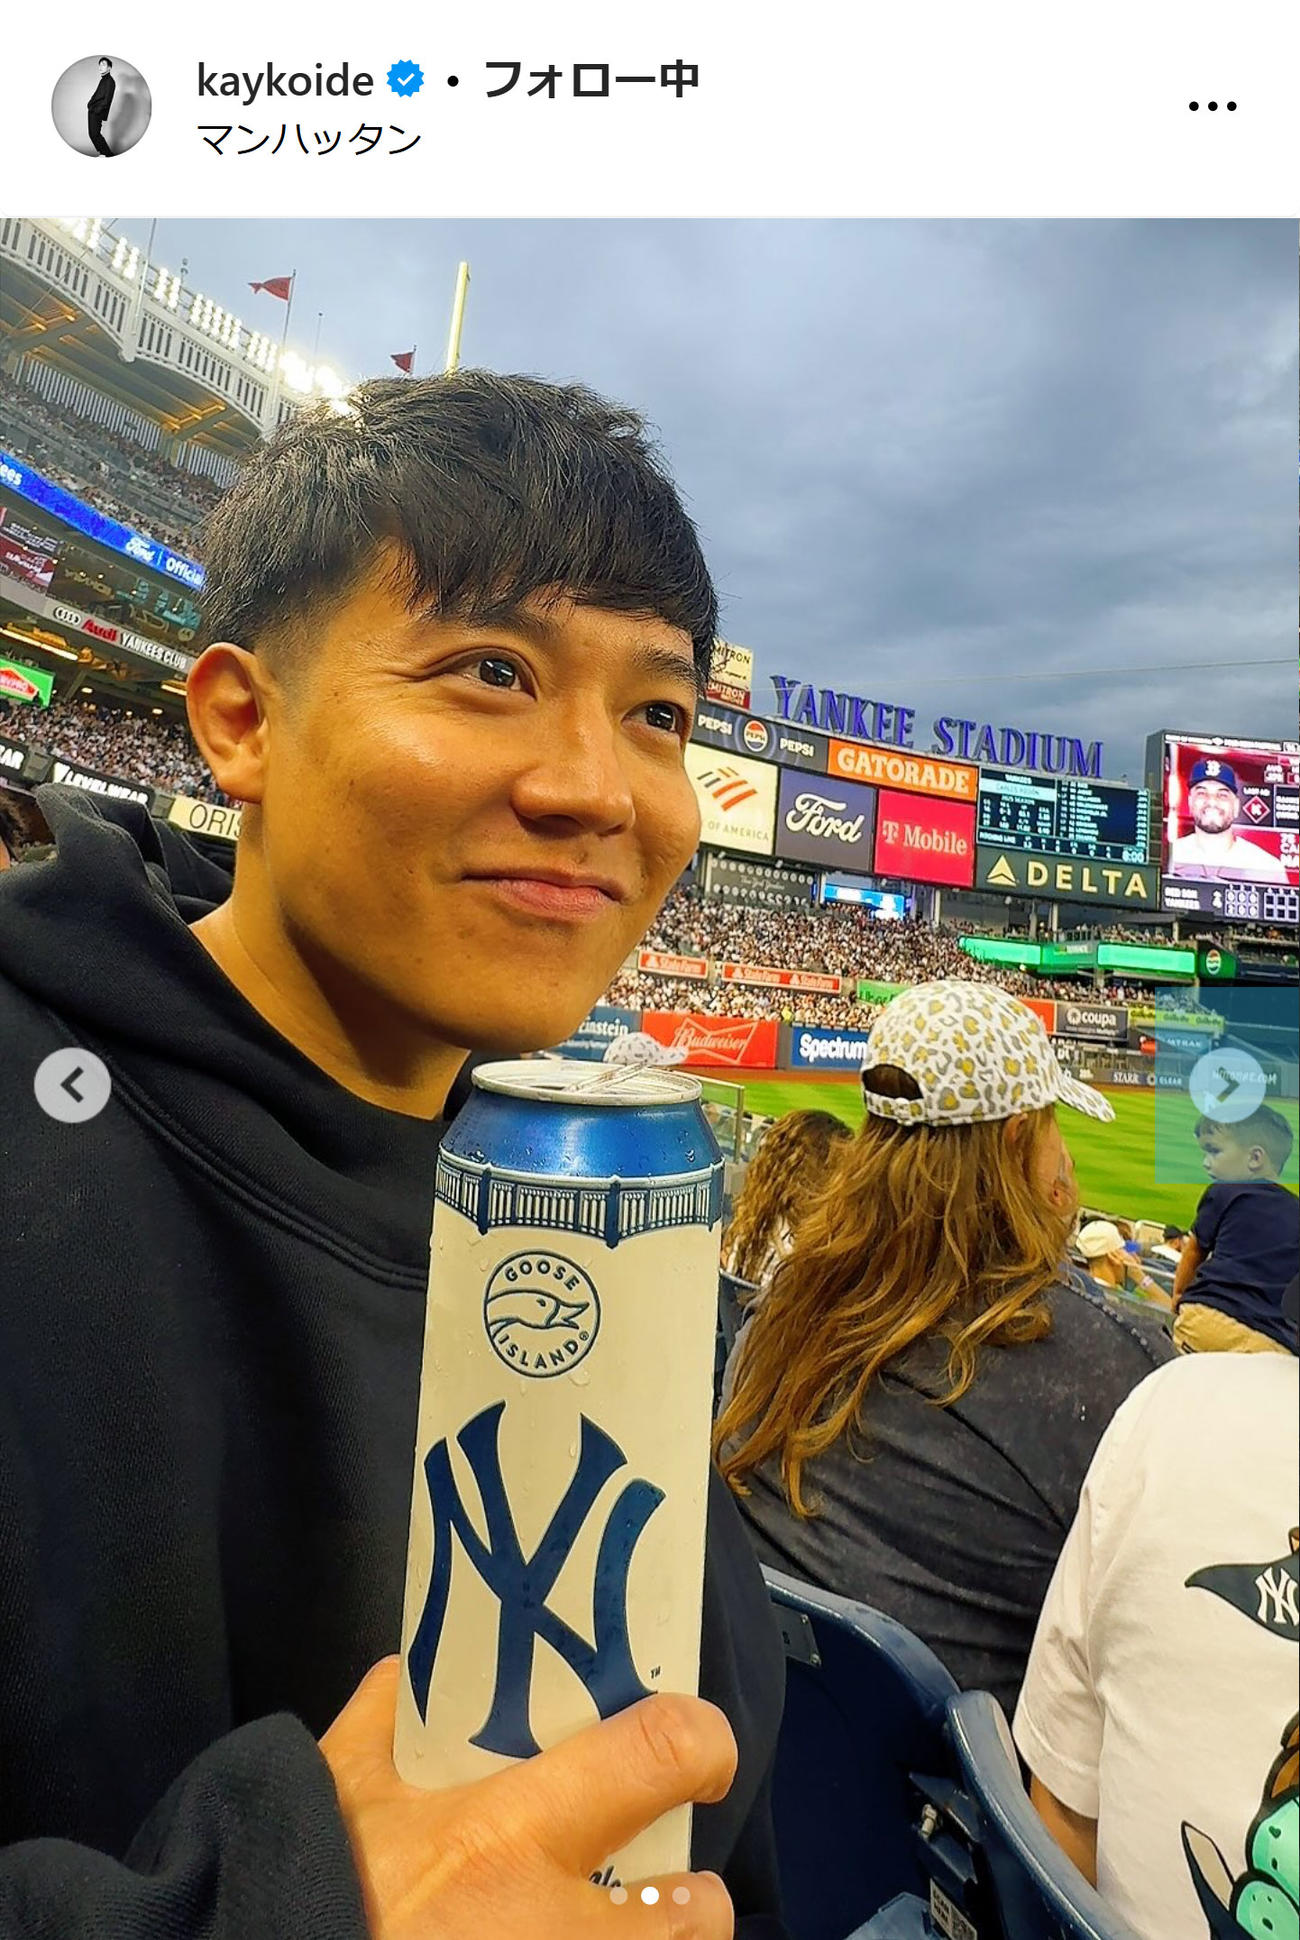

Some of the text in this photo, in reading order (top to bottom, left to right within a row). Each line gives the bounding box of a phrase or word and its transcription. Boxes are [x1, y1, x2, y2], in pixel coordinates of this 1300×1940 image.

[0, 462, 23, 487] ees
[82, 618, 188, 670] Audi YANKEES CLUB
[698, 714, 733, 735] PEPSI
[770, 675, 1104, 779] YANKEE STADIUM
[780, 737, 815, 757] PEPSI
[837, 747, 970, 794] GATORADE
[708, 820, 770, 842] OF AMERICA
[785, 793, 865, 843] Ford
[903, 824, 967, 856] Mobile
[1026, 860, 1148, 898] DELTA
[581, 1015, 629, 1036] instein
[1081, 1011, 1117, 1028] coupa
[672, 1027, 747, 1050] Budweiser
[799, 1033, 868, 1062] Spectrum
[1159, 1075, 1182, 1085] CLEAR
[505, 1260, 580, 1291] GOOSE
[498, 1333, 579, 1369] ISLAND
